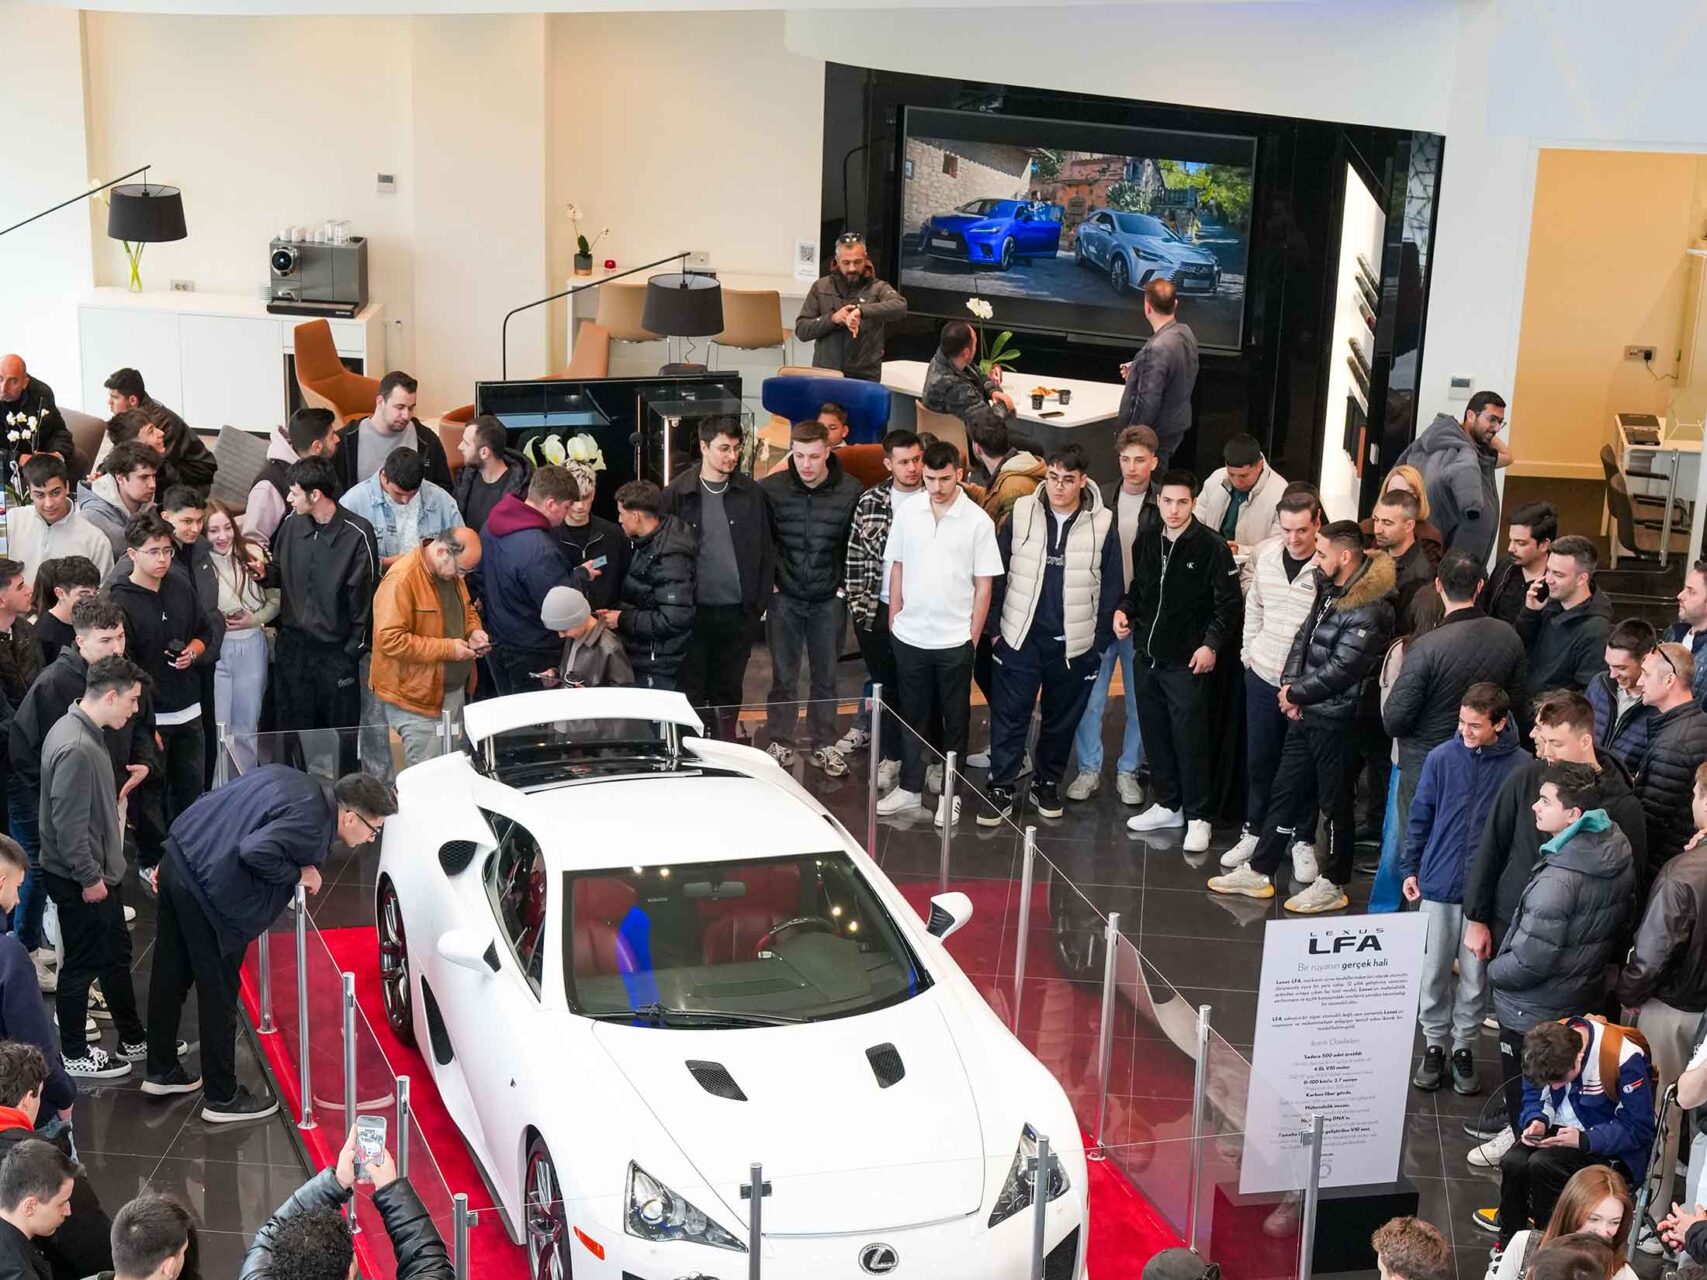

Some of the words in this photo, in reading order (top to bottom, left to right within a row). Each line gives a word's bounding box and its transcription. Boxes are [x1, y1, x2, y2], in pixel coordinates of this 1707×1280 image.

[1310, 928, 1384, 937] LEXUS
[1309, 935, 1382, 954] LFA
[1342, 959, 1371, 970] gerçek
[1373, 958, 1388, 967] hali
